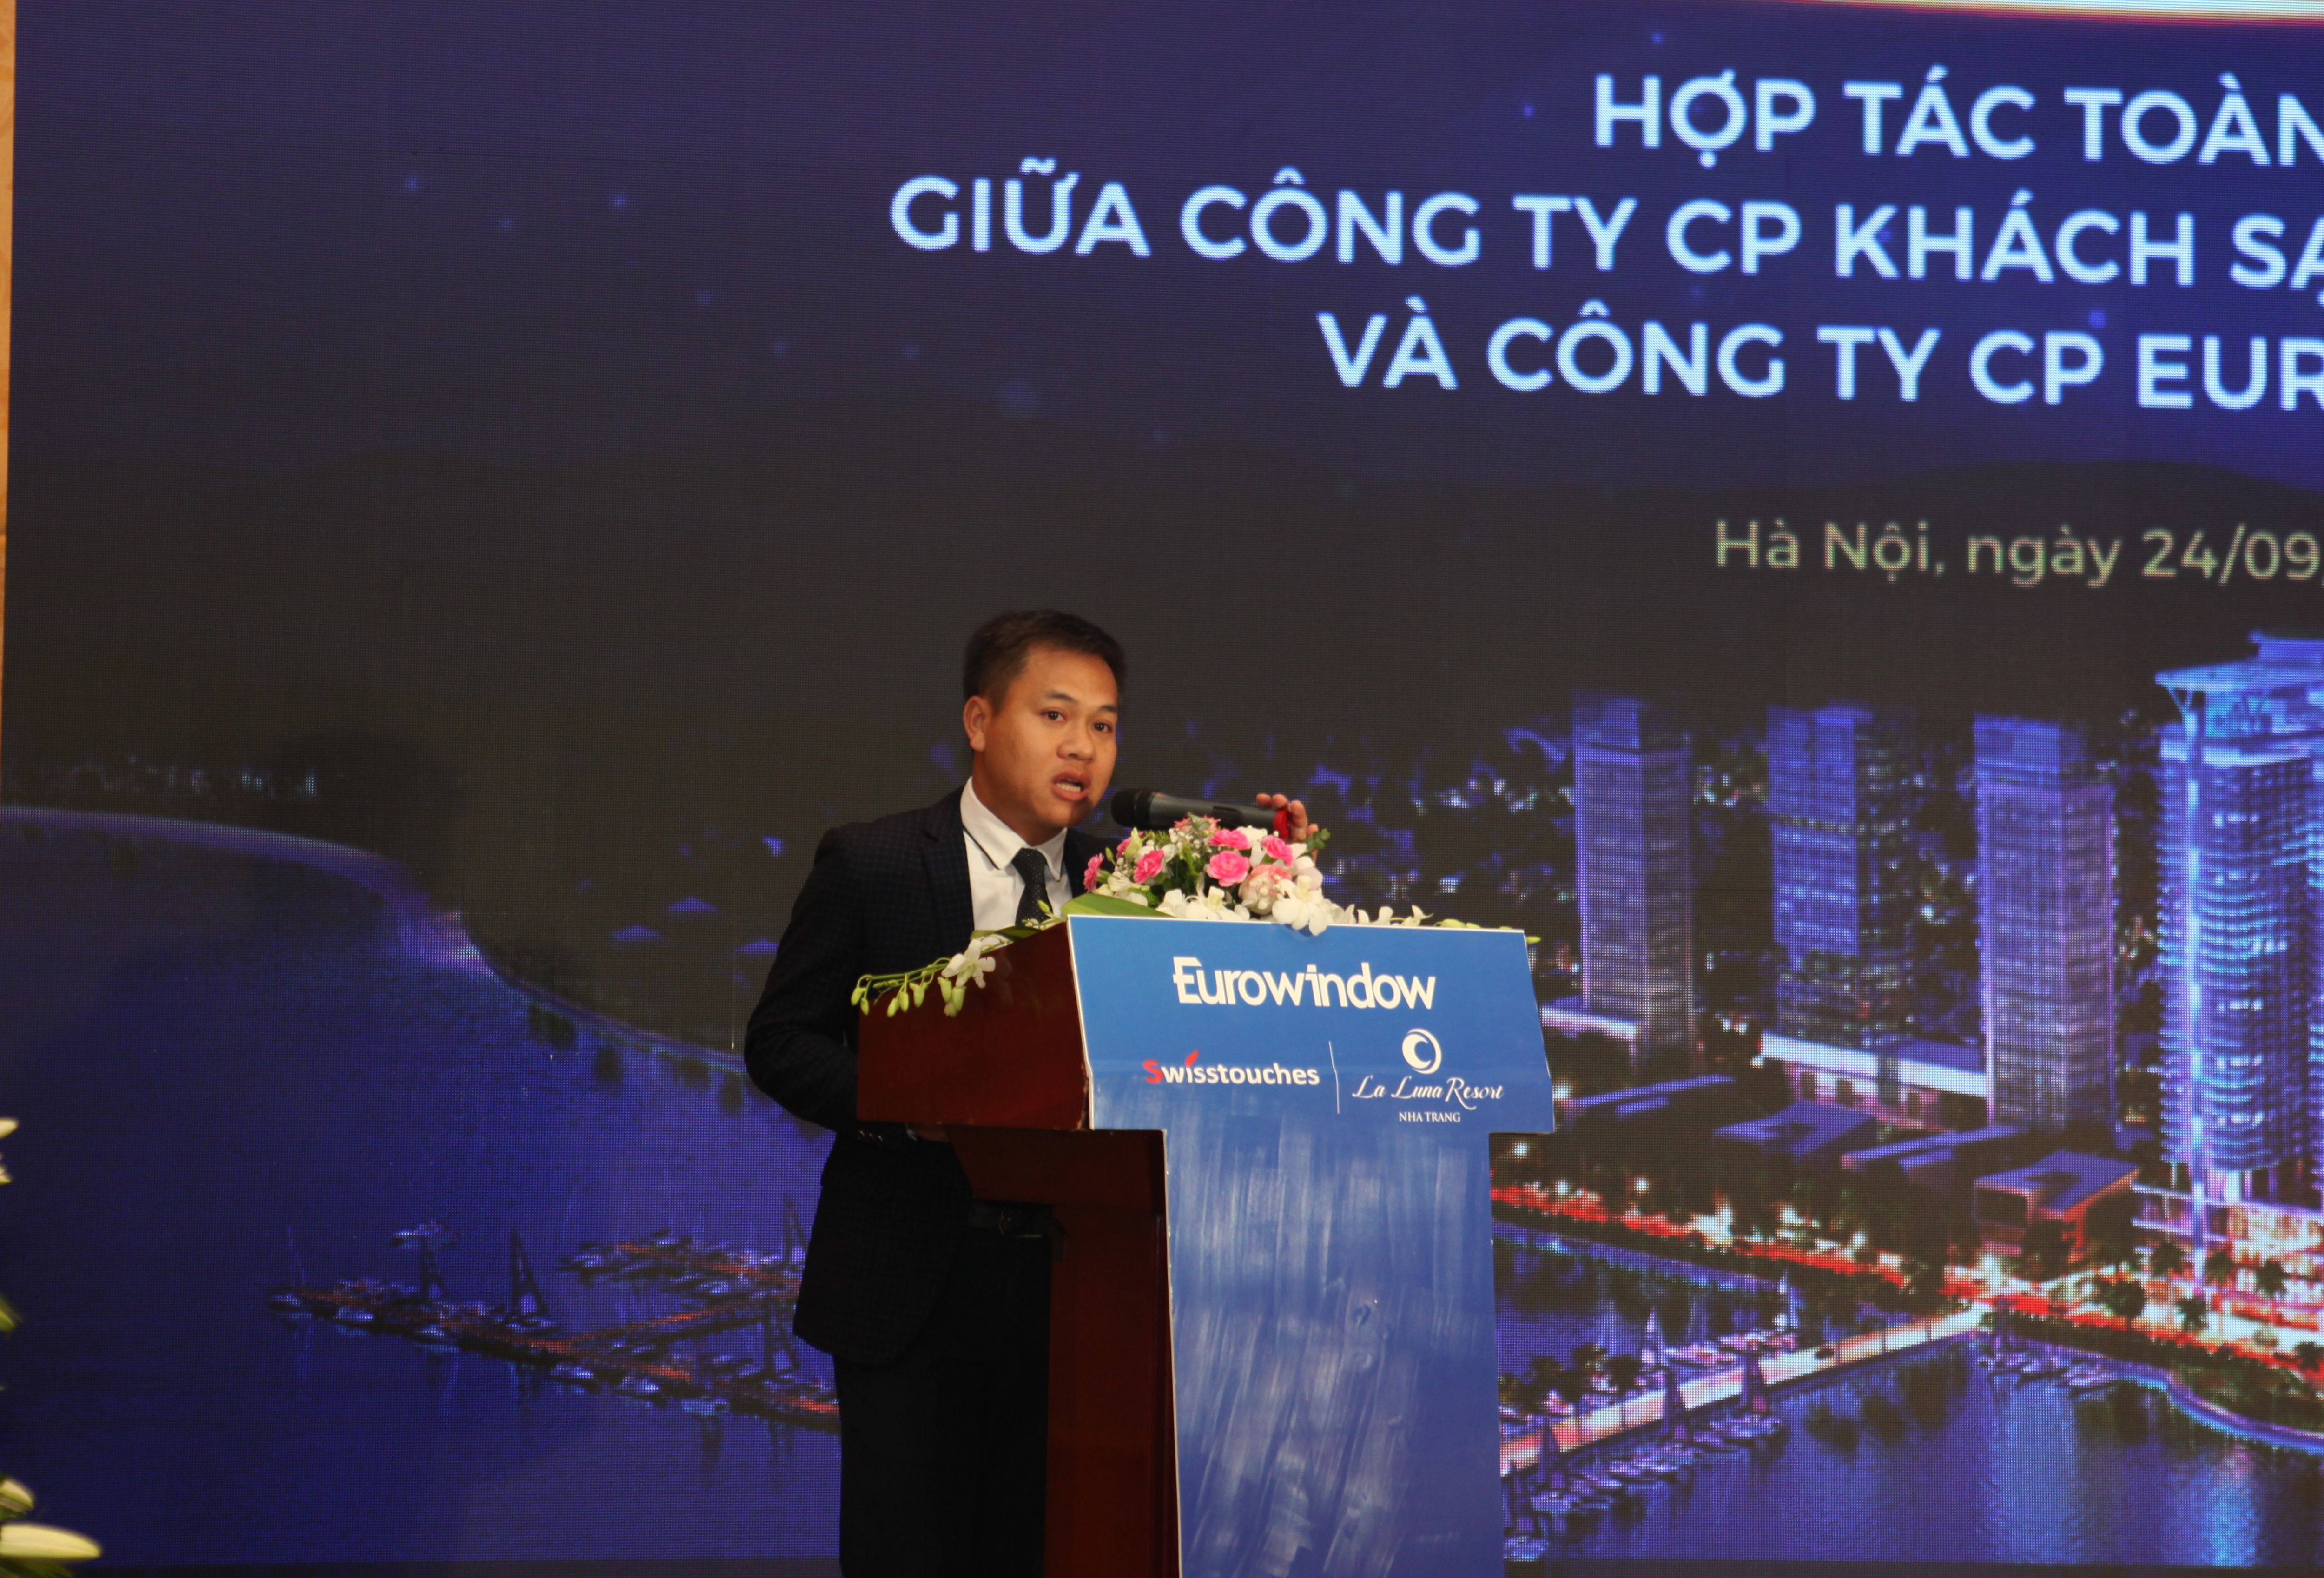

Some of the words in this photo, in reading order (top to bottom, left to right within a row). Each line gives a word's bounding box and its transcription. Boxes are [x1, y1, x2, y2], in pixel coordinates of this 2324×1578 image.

[1594, 68, 1816, 168] HỢP
[1842, 64, 2036, 160] TÁC
[2063, 72, 2324, 166] TOÀN
[890, 157, 1150, 257] GIỮA
[1179, 166, 1481, 267] CÔNG
[1512, 194, 1637, 271] TY
[1665, 199, 1802, 274] CP
[1834, 189, 2195, 286] KHÁCH
[1316, 296, 1458, 390] VÀ
[1486, 299, 1786, 398] CÔNG
[1816, 325, 1941, 402] TY
[1968, 330, 2105, 405] CP
[2137, 334, 2324, 411] EUR
[1715, 517, 1800, 569] Hà
[1824, 520, 1945, 582] Nội,
[1967, 525, 2122, 587] ngày
[2141, 525, 2324, 585] 24/09
[1172, 956, 1436, 1010] Eurowindow
[1142, 1050, 1320, 1086] Swisstouches
[1351, 1074, 1386, 1100] La
[1390, 1075, 1443, 1100] Luna
[1444, 1076, 1504, 1111] Resort
[1398, 1111, 1424, 1123] NHA
[1424, 1111, 1461, 1123] TRANG
